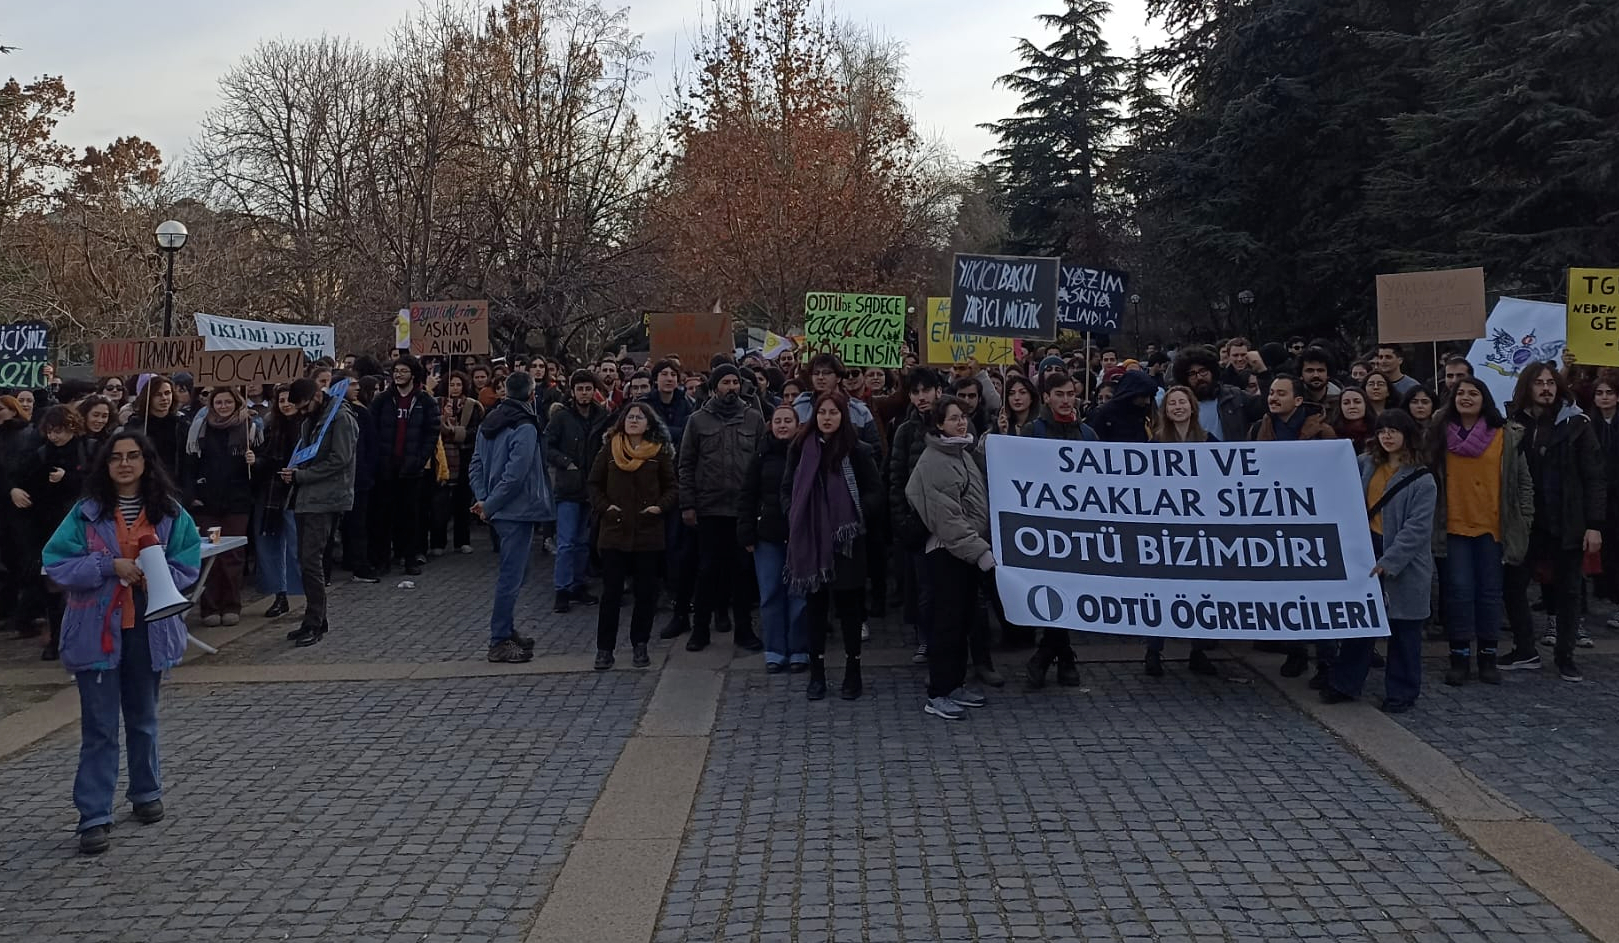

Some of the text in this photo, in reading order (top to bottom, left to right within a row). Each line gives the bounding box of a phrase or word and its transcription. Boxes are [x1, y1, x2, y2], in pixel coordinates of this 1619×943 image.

[998, 263, 1037, 292] BASKI
[1062, 266, 1124, 293] YAZIM
[855, 296, 902, 315] SADECE
[962, 294, 1000, 327] YAPICI
[1002, 298, 1042, 329] MÜZİK
[1573, 303, 1616, 314] NEDEN
[272, 330, 325, 347] DEĞİL
[424, 322, 470, 338] ASKIYA
[430, 339, 473, 354] ALINDI
[198, 351, 302, 383] HOCAM!
[1058, 446, 1260, 477] SALDIRI VE
[1011, 479, 1318, 517] YASAKLAR SİZİN
[1014, 525, 1329, 567] ODTÜ BİZİMDİR!
[1076, 592, 1381, 631] ODTÜ ÖĞRENCİLERİ
